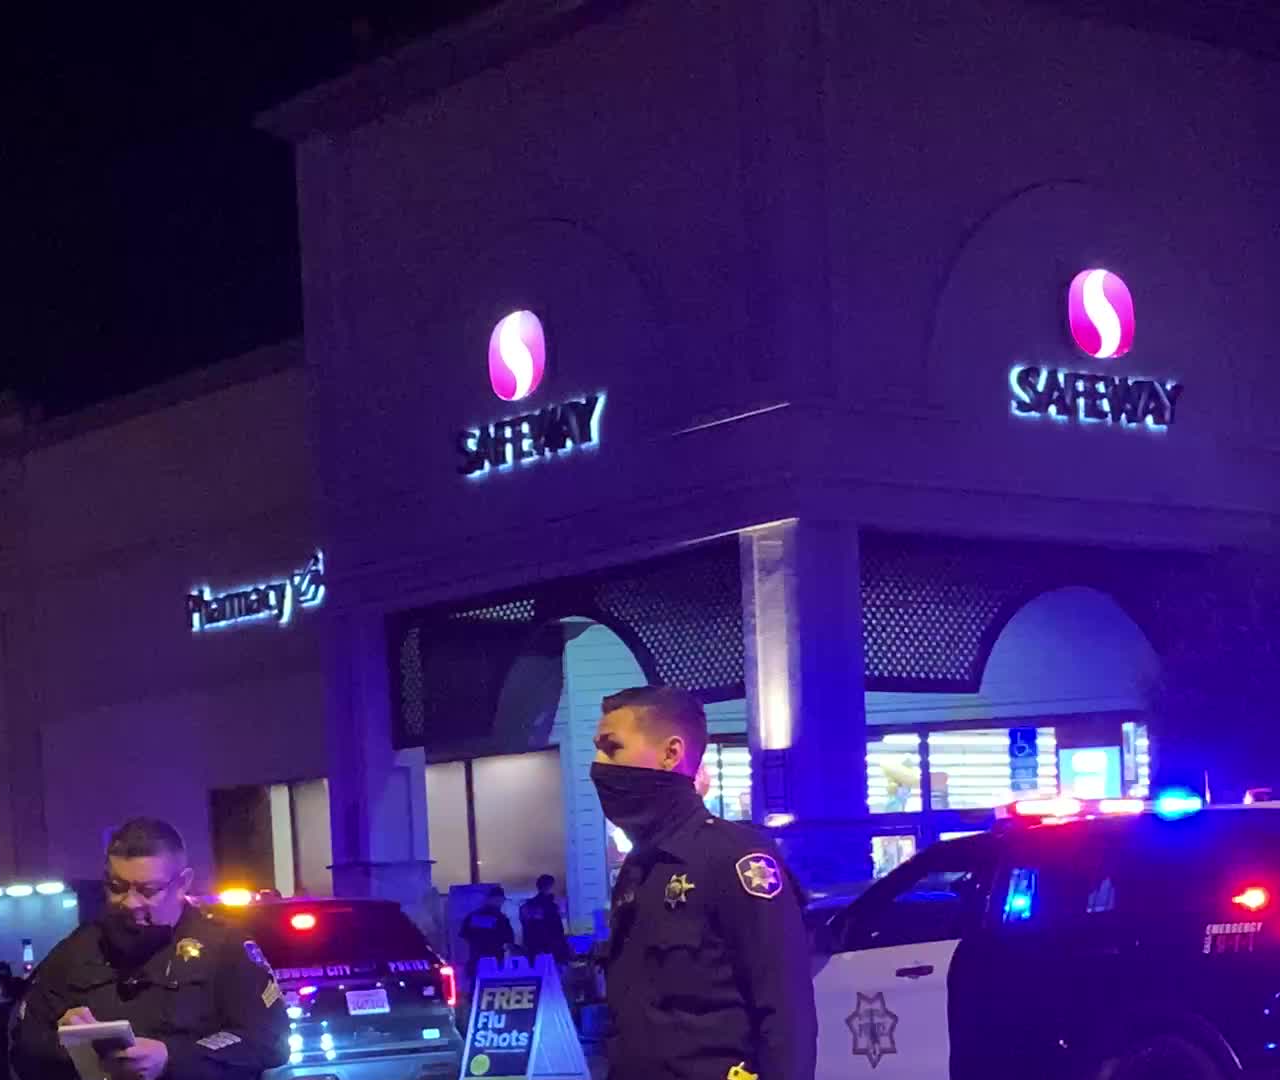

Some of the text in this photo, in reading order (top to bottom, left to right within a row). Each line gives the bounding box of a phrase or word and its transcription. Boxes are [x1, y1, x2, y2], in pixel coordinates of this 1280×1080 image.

[1009, 366, 1184, 432] SAFEWAY
[458, 392, 606, 478] SAFEWAY
[186, 581, 292, 632] Pharmacy
[326, 964, 351, 977] CITY
[481, 985, 537, 1010] FREE
[477, 1011, 506, 1029] Flu
[474, 1030, 529, 1048] Shots
